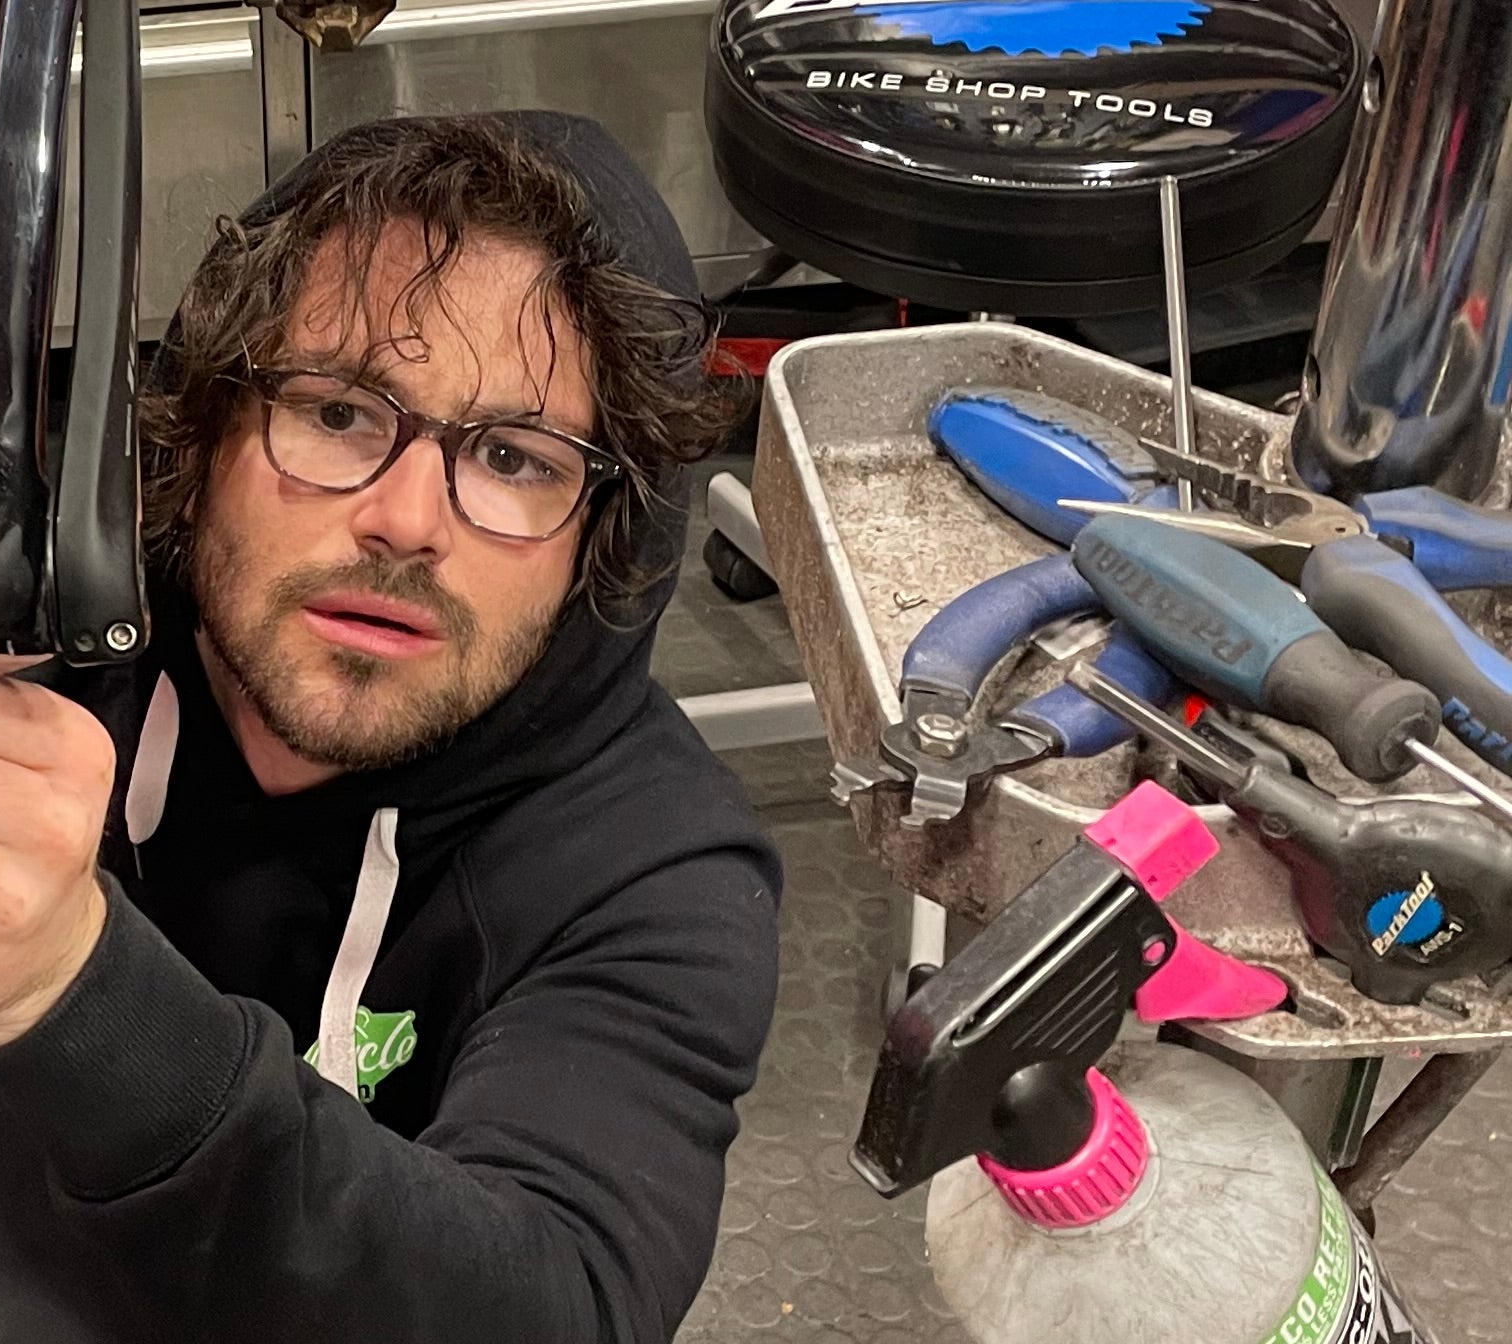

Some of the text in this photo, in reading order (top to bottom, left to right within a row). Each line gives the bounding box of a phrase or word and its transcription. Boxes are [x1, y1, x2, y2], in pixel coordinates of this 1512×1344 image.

[807, 71, 1214, 128] BIKE SHOP TOOLS
[1372, 870, 1434, 956] ParkTool
